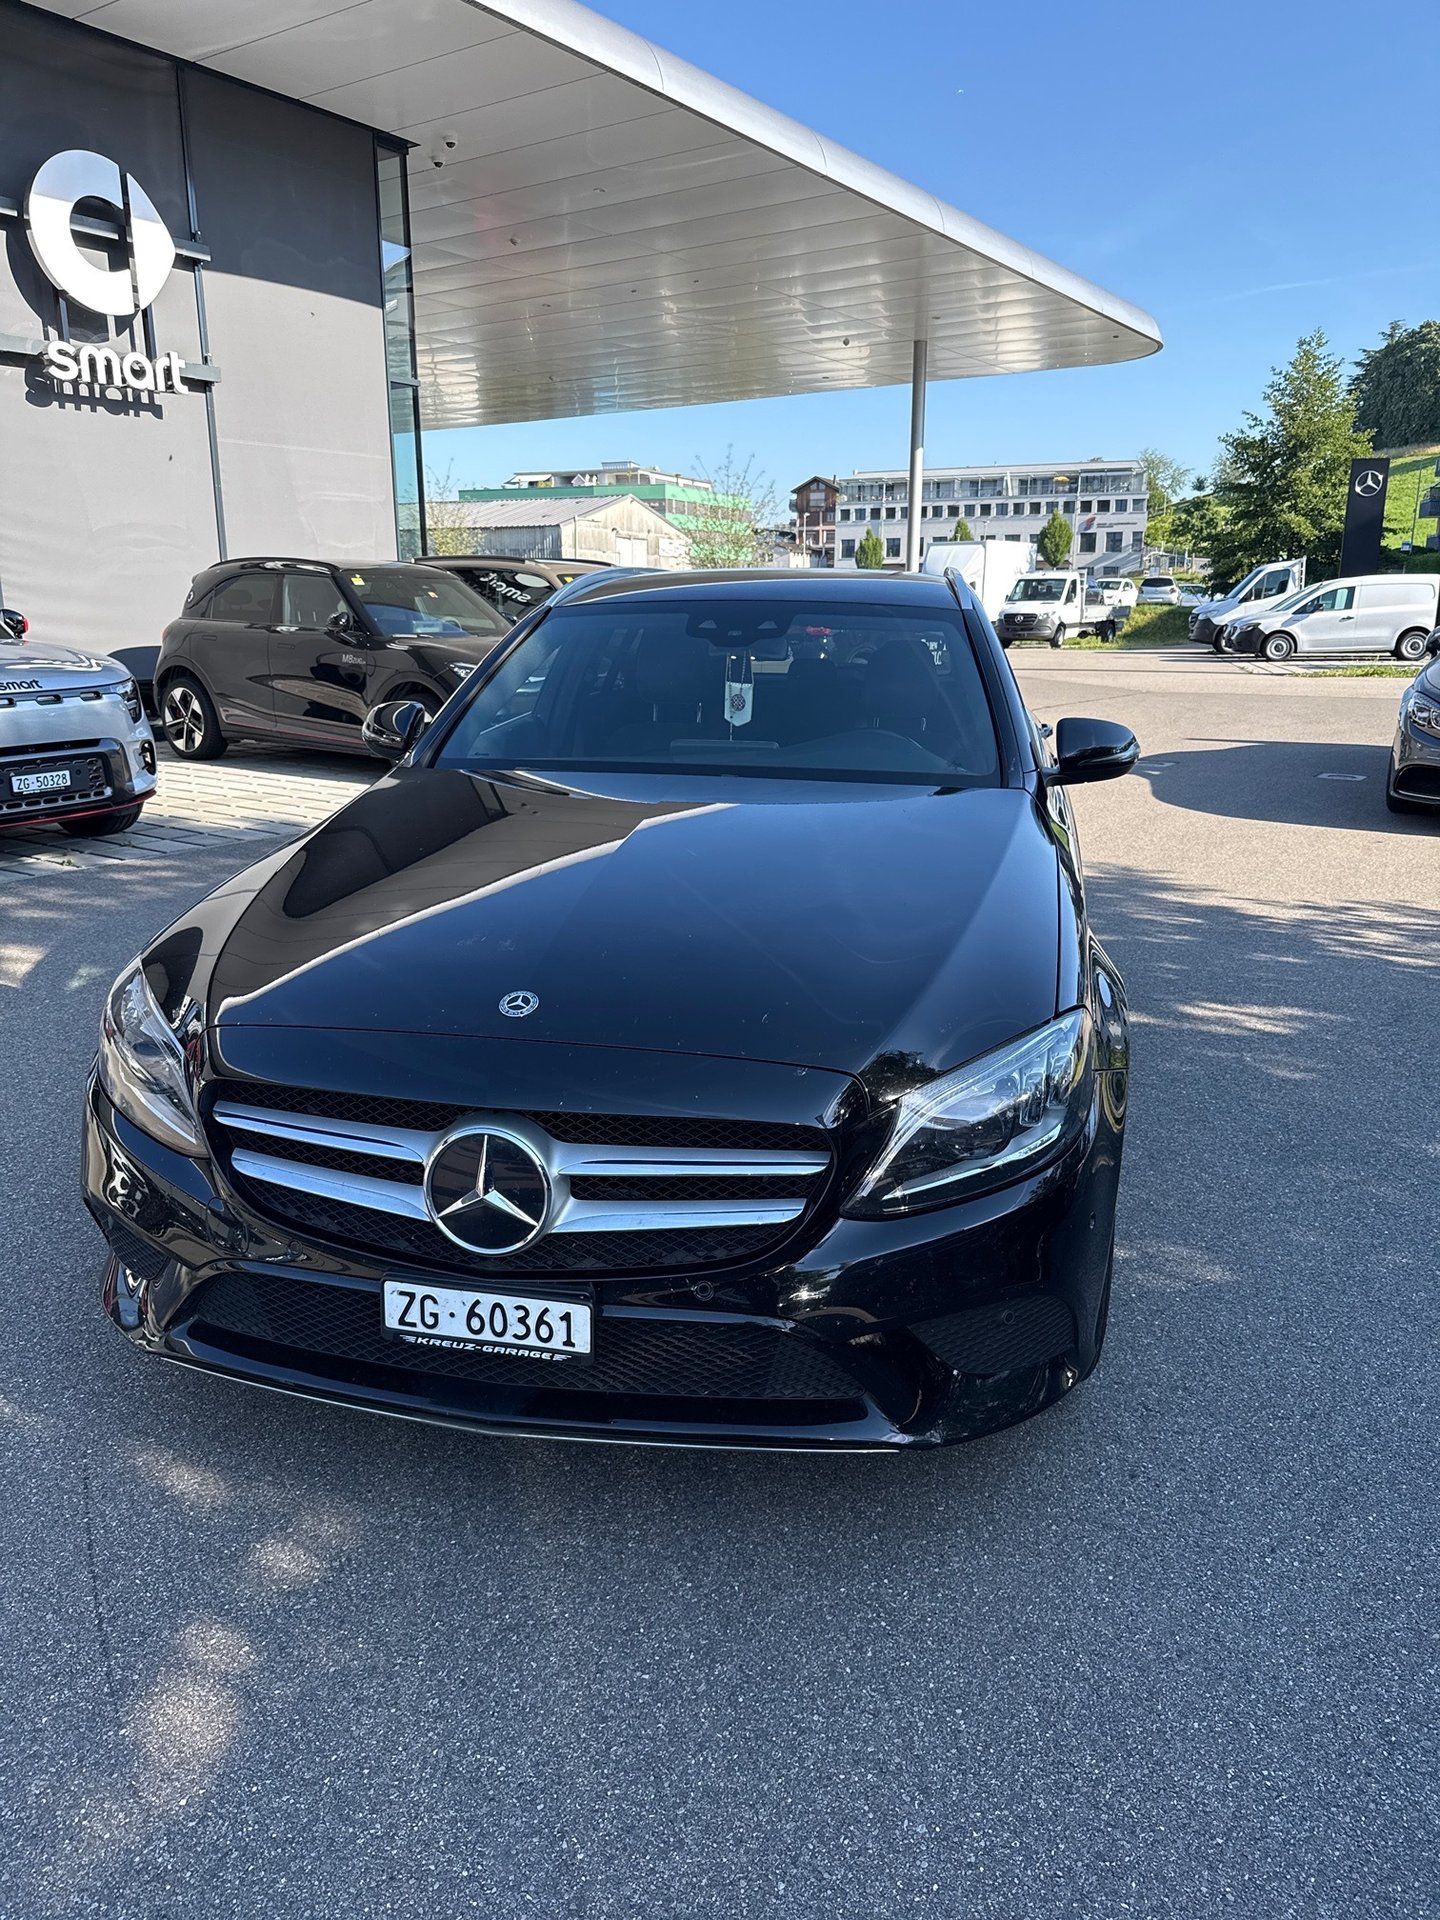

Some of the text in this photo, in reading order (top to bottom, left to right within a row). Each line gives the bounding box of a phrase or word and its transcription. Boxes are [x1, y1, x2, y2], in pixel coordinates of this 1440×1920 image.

[46, 340, 189, 395] smart
[0, 679, 43, 691] smart
[416, 1336, 554, 1360] KREUZ-GARAGE
